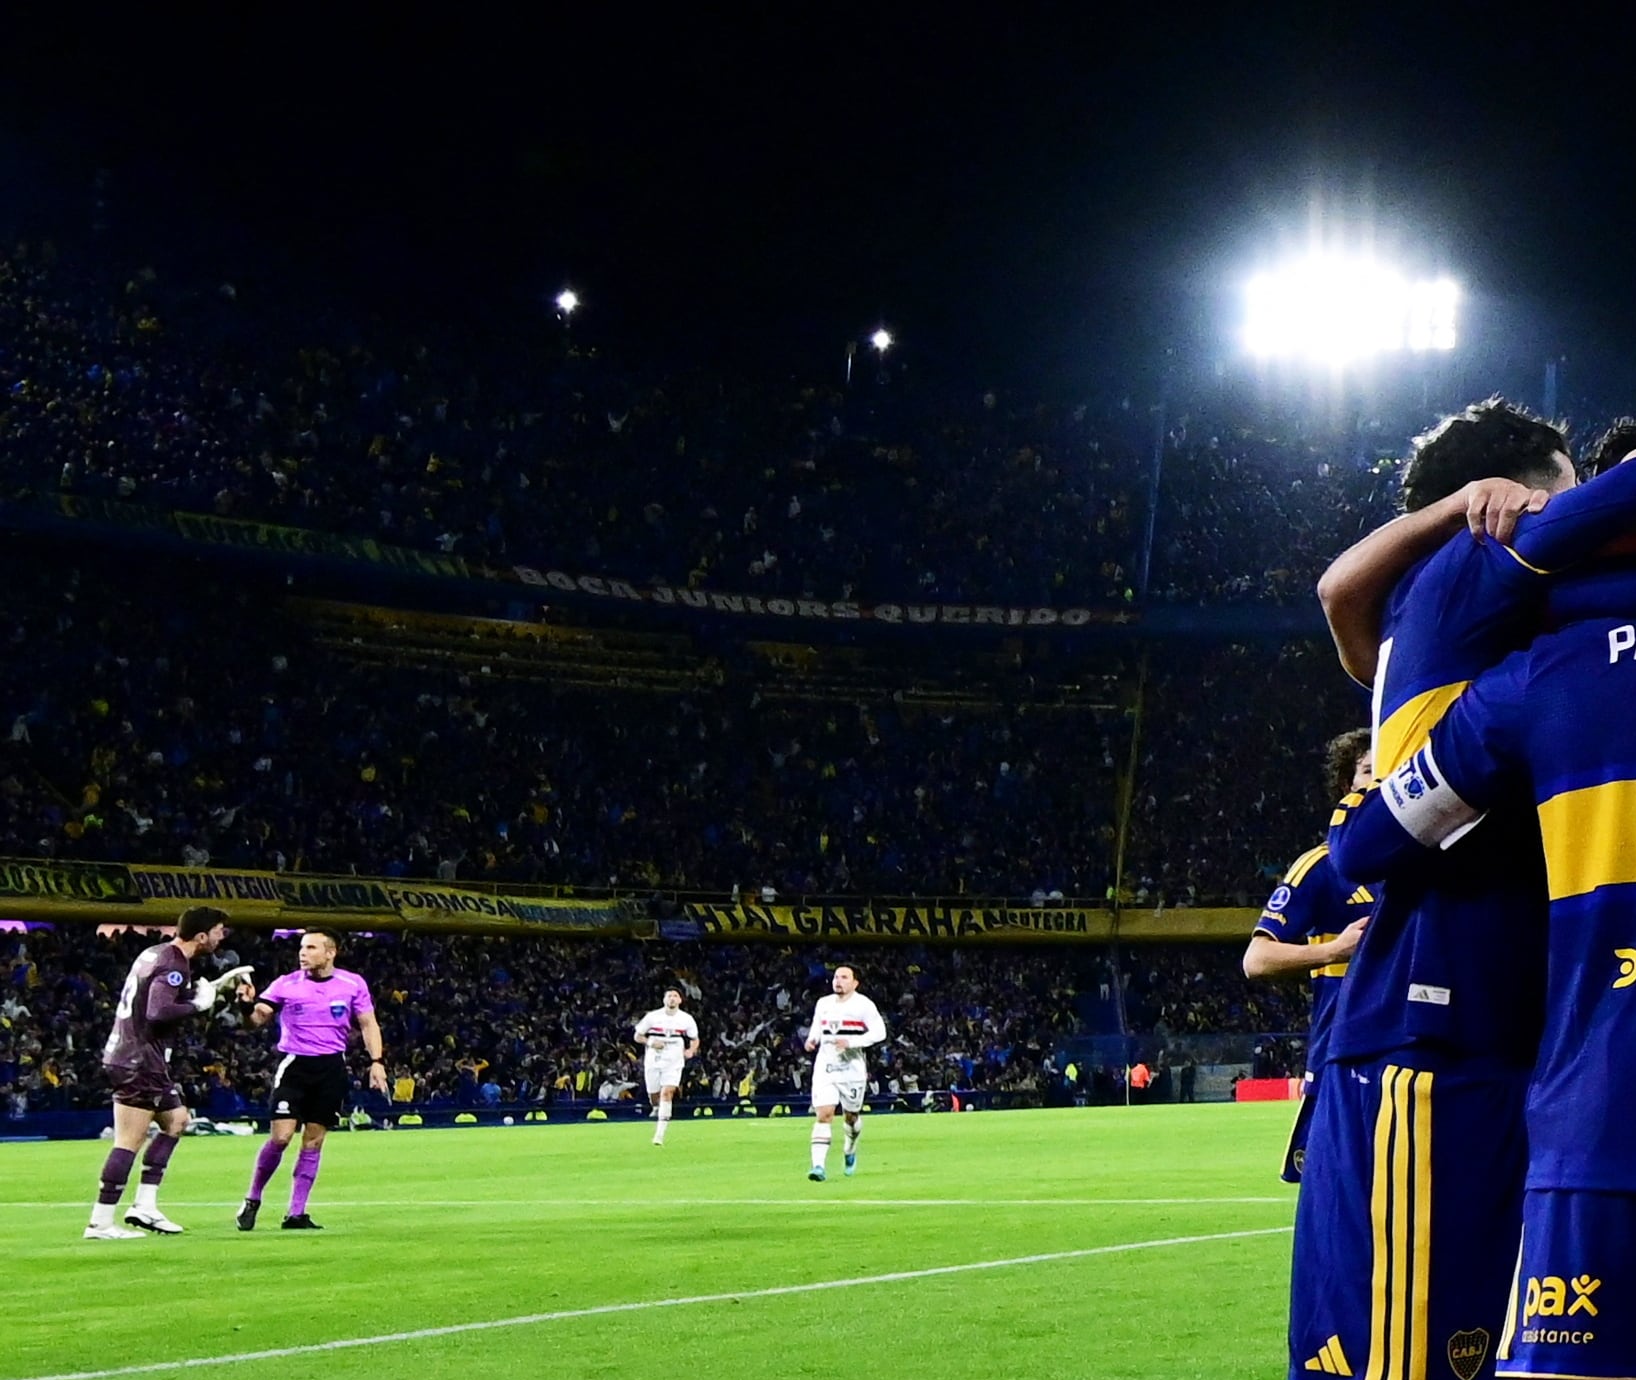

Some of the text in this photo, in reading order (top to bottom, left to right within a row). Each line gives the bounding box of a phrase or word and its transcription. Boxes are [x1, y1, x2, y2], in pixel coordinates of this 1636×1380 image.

[513, 565, 1092, 627] BOCA JUNIORS QUERIDO
[387, 889, 517, 918] FORMOSA
[793, 904, 1008, 937] GARRAHAN
[1522, 1274, 1602, 1328] pax
[1452, 1343, 1483, 1359] CABJ
